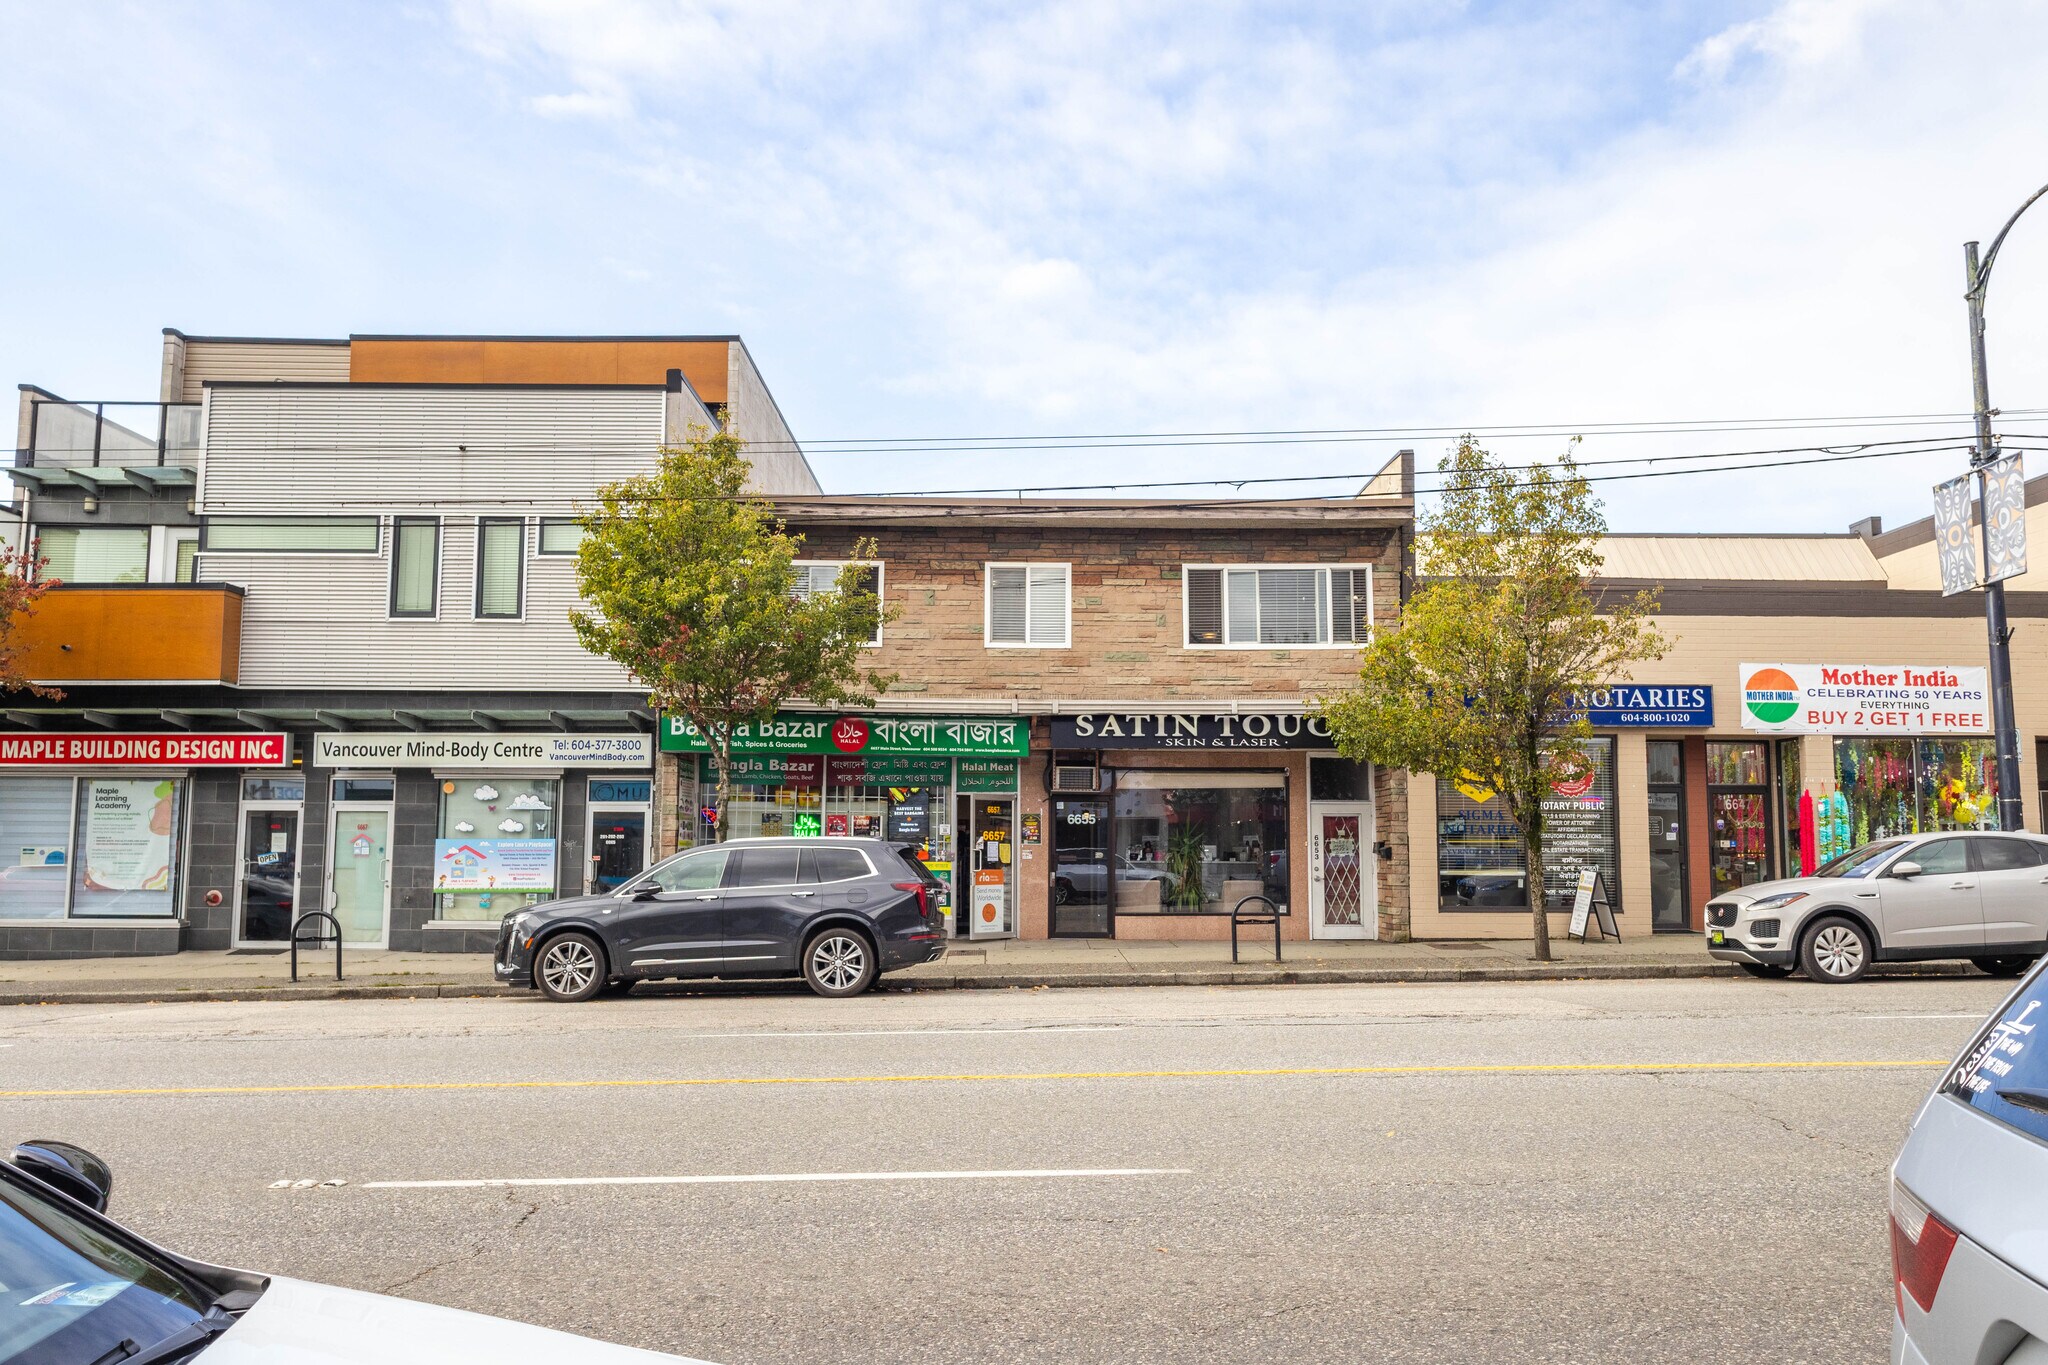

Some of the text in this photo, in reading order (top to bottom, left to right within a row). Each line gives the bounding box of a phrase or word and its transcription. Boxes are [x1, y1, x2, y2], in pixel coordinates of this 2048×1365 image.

[1822, 668, 1958, 687] Mother India
[1746, 692, 1774, 700] MOTHER
[1776, 692, 1794, 700] INDIA
[1807, 688, 1982, 700] CELEBRATING 50 YEARS
[1860, 701, 1930, 710] EVERYTHING
[1620, 713, 1690, 722] 604-800-1020
[1808, 710, 1984, 727] BUY 2 GET 1 FREE
[760, 717, 828, 738] Bazar
[838, 722, 863, 738] حلال
[1076, 714, 1333, 738] SATIN TOUC
[873, 718, 1018, 746] বাংলা বাজার
[553, 740, 641, 750] Tel: 604-377-3800
[1165, 738, 1281, 747] SKIN & LASER
[2, 740, 278, 759] MAPLE BUILDING DESIGN INC.
[322, 741, 543, 761] Vancouver Mind-Body Centre
[549, 753, 645, 762] VancouverMindBody.com
[708, 758, 763, 773] Bngla
[769, 759, 815, 772] Bazar
[962, 762, 1014, 771] Halal Meat
[962, 777, 985, 786] الحلال
[96, 795, 128, 803] Learning
[1574, 802, 1605, 810] PUBLIC
[1067, 814, 1096, 824] 6655
[1458, 810, 1504, 820] SIGMA
[983, 831, 1006, 840] 6657
[260, 853, 277, 863] OPEN
[979, 872, 990, 882] ria
[1998, 1037, 2015, 1051] THE
[1952, 1031, 2000, 1084] Jesus
[1981, 1056, 1998, 1069] THE
[1966, 1074, 1991, 1093] THE LIFE
